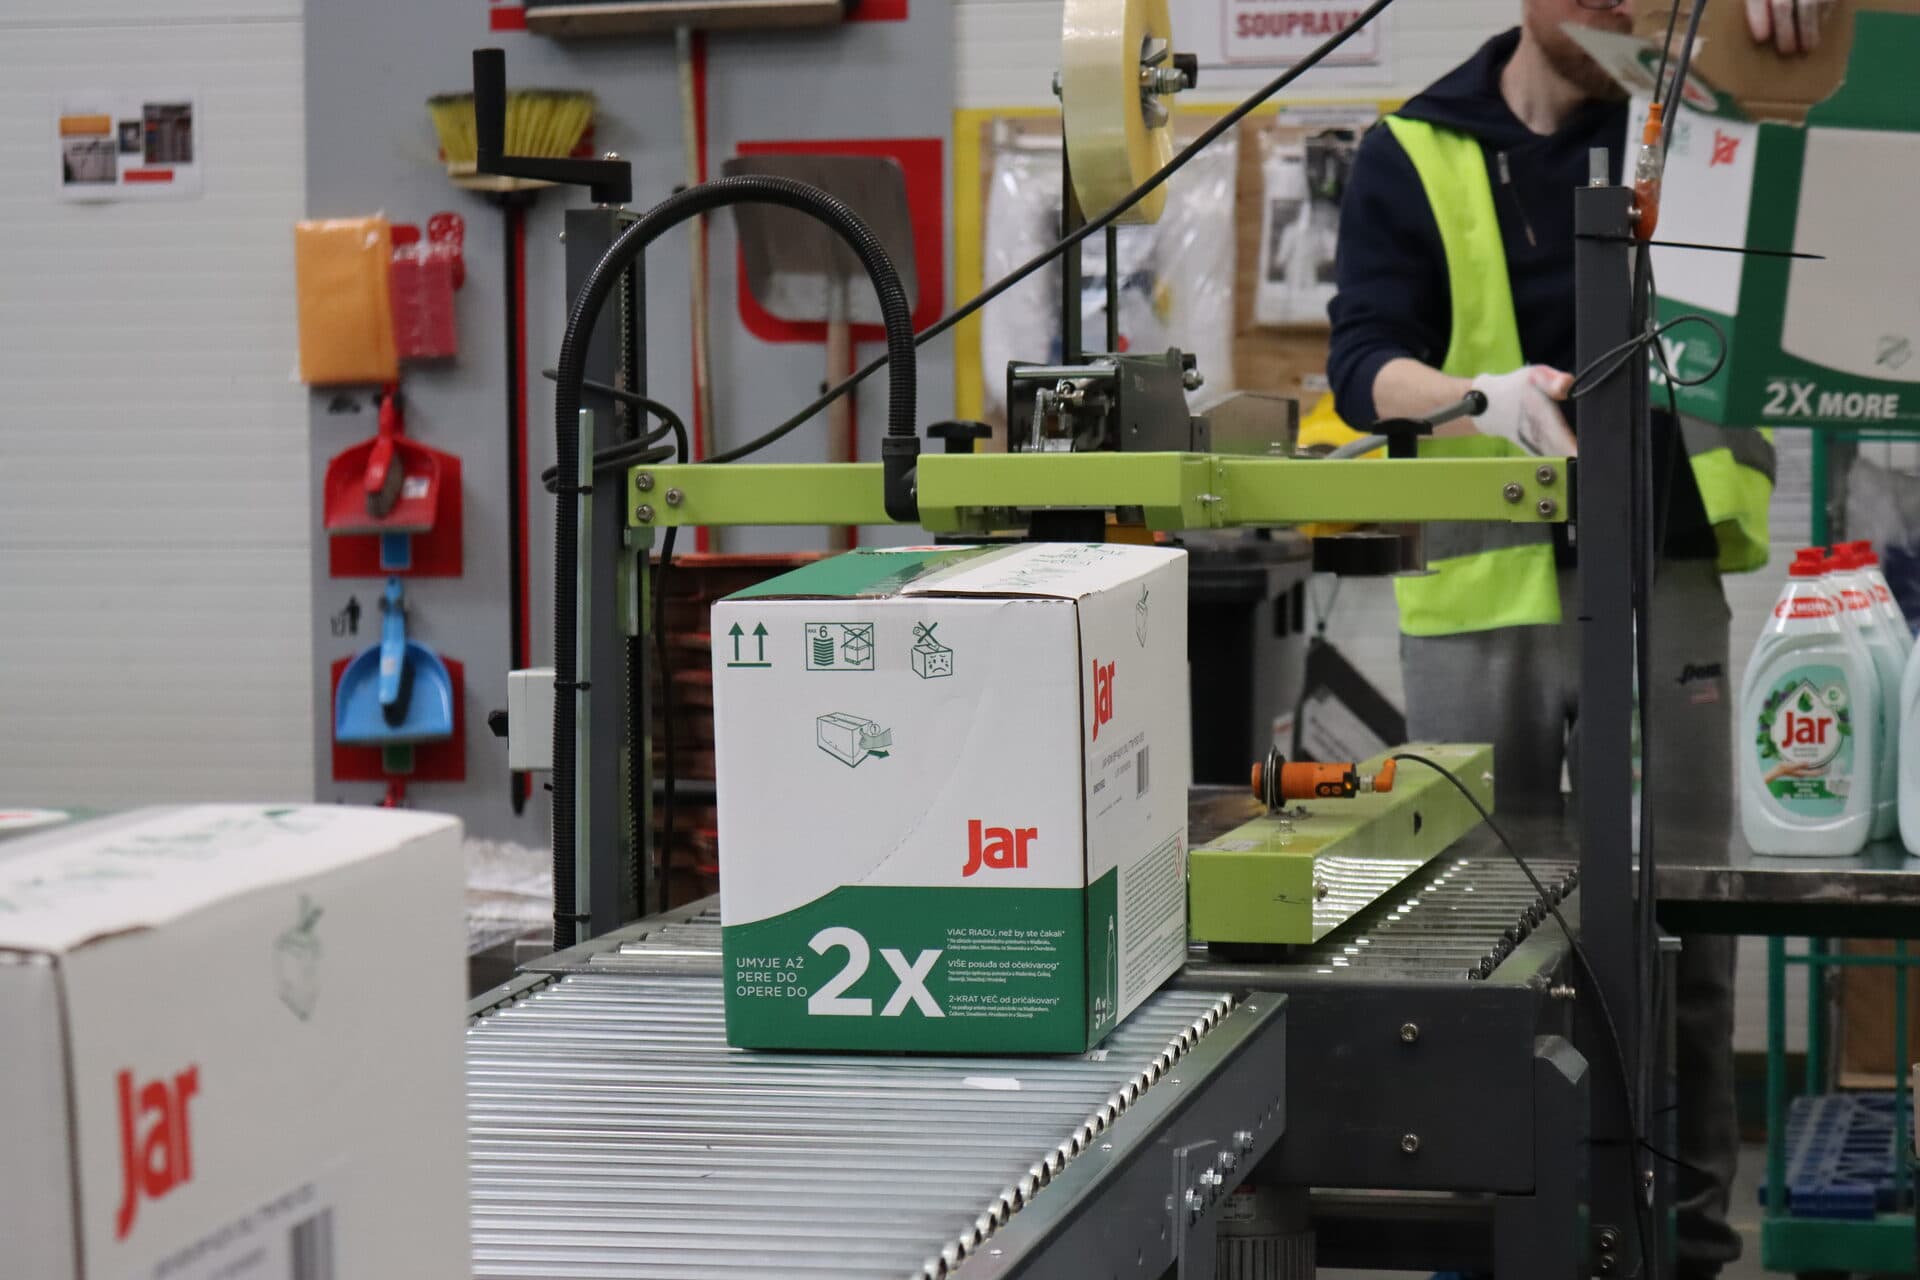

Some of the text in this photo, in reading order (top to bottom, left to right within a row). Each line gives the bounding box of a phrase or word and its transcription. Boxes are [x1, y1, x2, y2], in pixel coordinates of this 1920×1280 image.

[1763, 382, 1899, 418] 2X MORE
[819, 625, 828, 639] 6
[1092, 658, 1115, 743] Jar
[1782, 711, 1832, 748] Jar
[962, 819, 1038, 877] Jar
[947, 928, 967, 936] VIAC
[968, 929, 997, 937] RIADU,
[998, 929, 1012, 937] než
[1014, 930, 1024, 938] by
[736, 956, 804, 968] UMYJE AŽ
[948, 959, 967, 968] VIŠE
[736, 972, 797, 983] PERE DO
[807, 926, 946, 1018] 2x
[736, 986, 808, 998] OPERE DO
[948, 995, 978, 1003] 2-KRAT
[1000, 996, 1010, 1004] od
[116, 1065, 200, 1243] Jar
